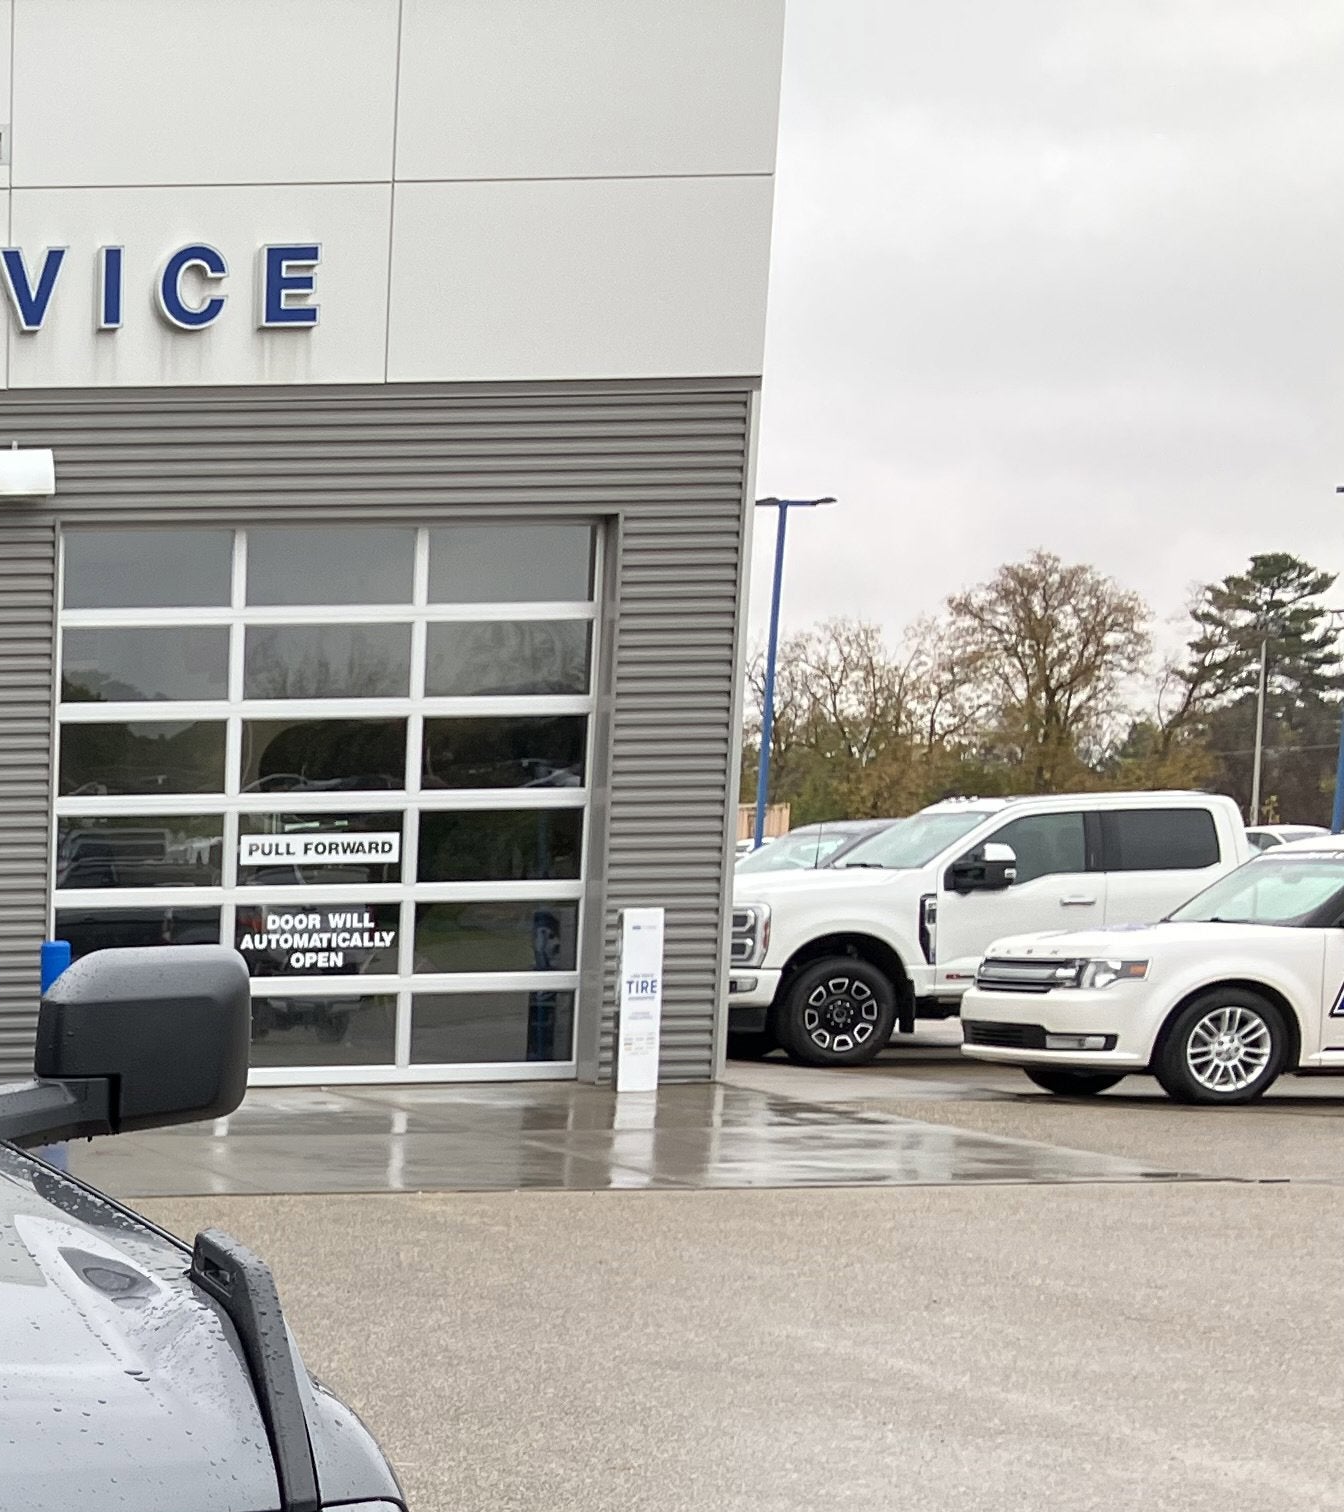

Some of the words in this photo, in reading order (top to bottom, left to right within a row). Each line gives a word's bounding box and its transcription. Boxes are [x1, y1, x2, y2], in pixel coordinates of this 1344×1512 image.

[248, 842, 296, 857] PULL
[303, 841, 393, 855] FORWARD
[267, 914, 321, 930] DOOR
[328, 912, 375, 929] WILL
[240, 931, 396, 950] AUTOMATICALLY
[290, 952, 344, 968] OPEN
[626, 979, 658, 994] TIRE
